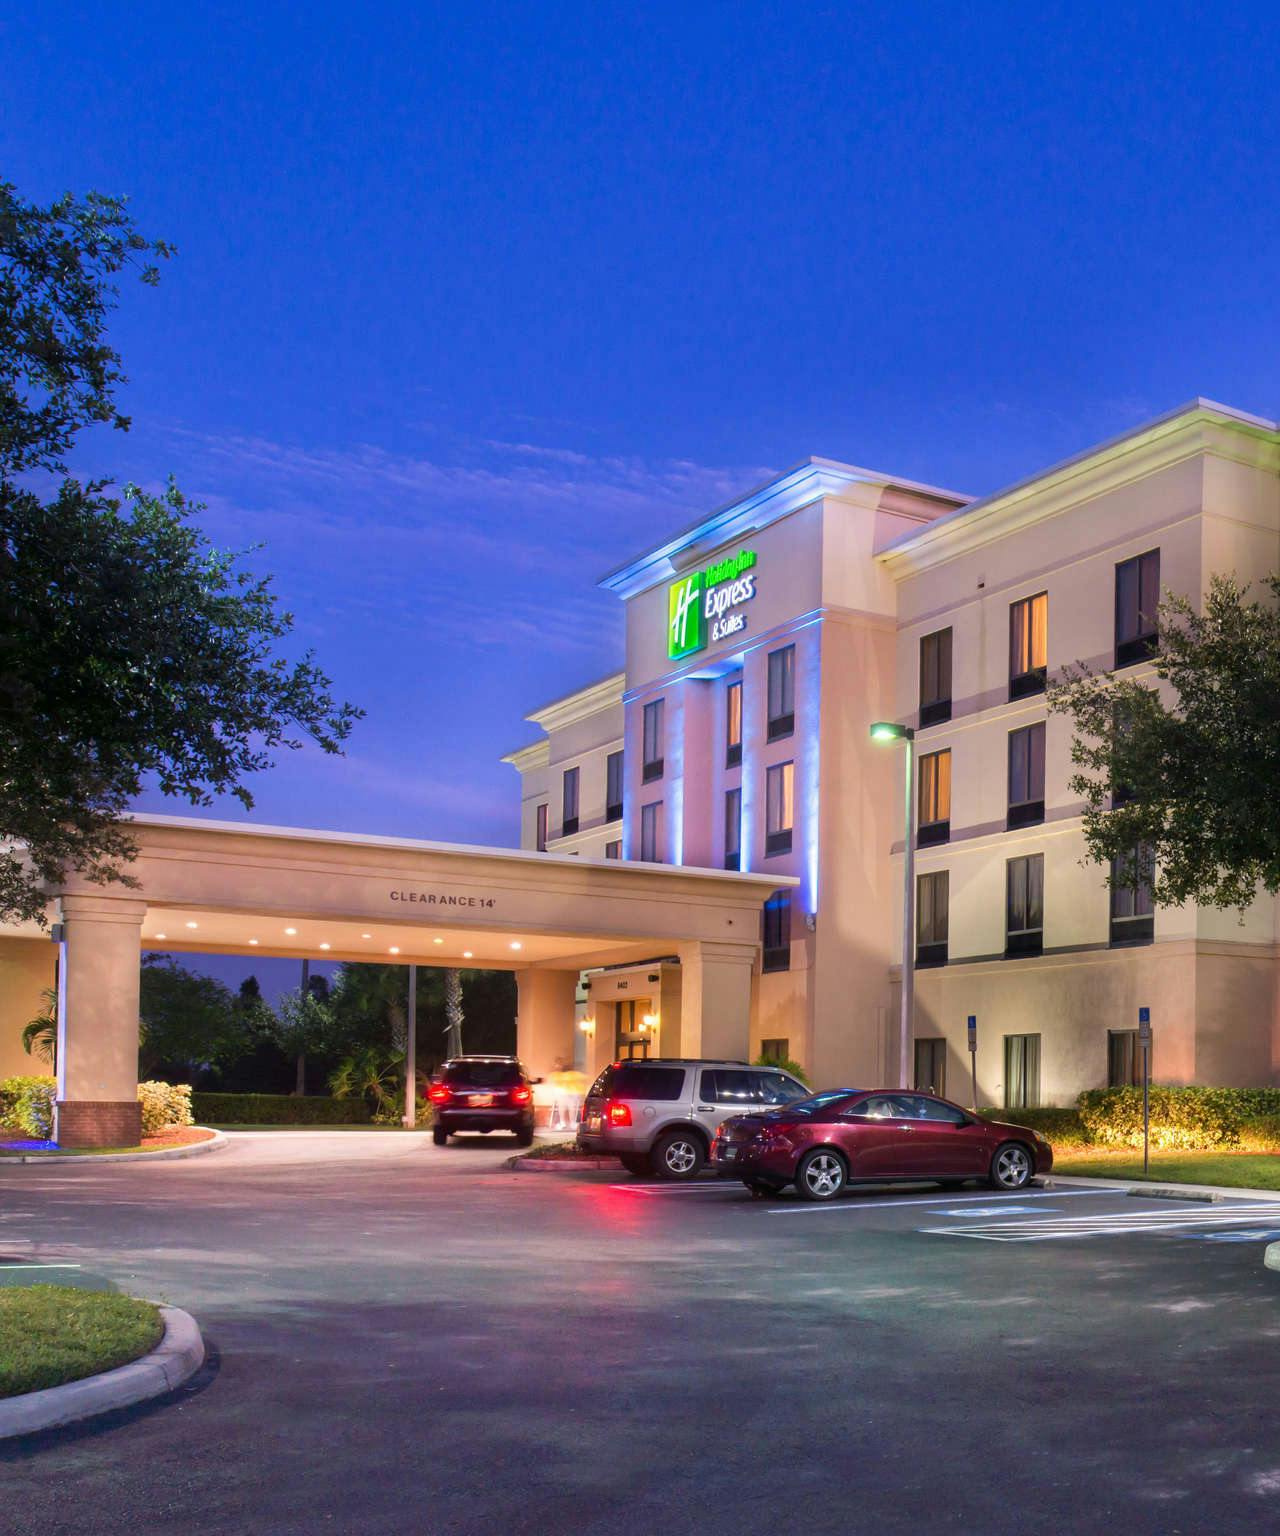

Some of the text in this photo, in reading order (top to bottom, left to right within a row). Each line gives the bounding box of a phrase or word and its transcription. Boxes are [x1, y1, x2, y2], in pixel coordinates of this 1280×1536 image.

[705, 575, 753, 618] Express
[712, 614, 743, 640] & Suites
[390, 891, 476, 907] CLEARANCE
